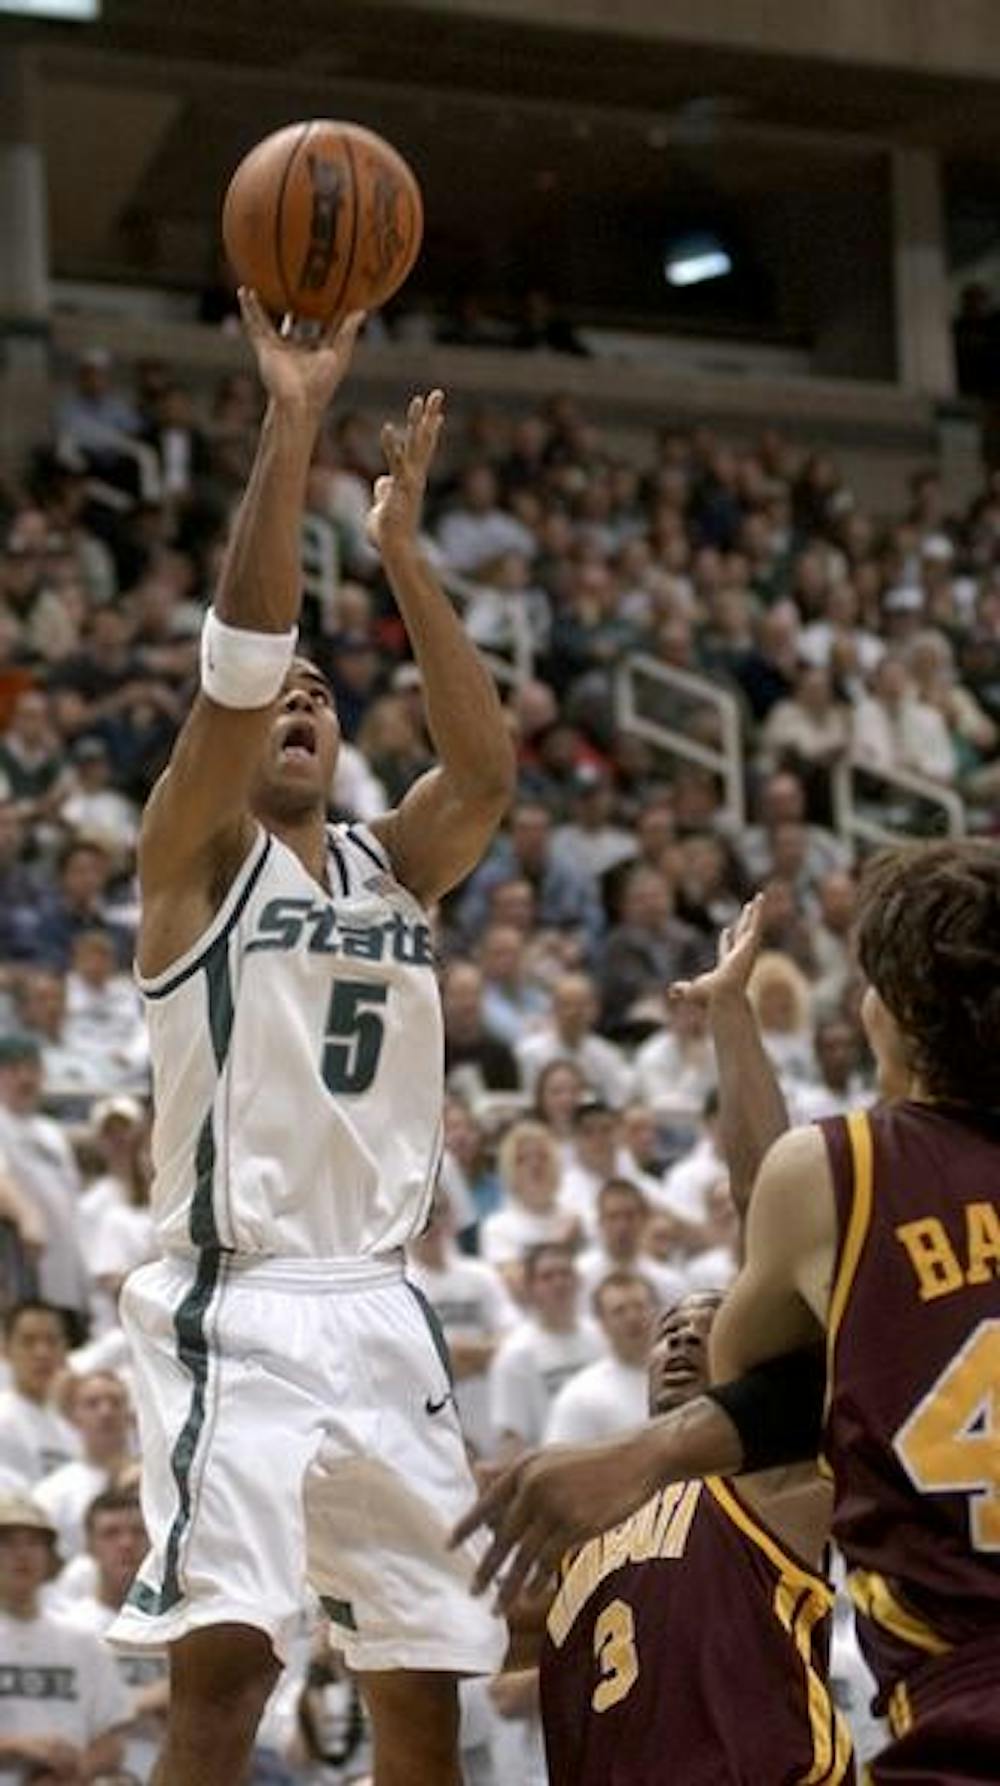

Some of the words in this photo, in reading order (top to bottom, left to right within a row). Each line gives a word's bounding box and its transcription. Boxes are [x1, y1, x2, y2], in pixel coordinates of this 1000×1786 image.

[320, 979, 389, 1095] 5
[892, 1317, 1000, 1552] 4
[590, 1598, 640, 1714] 3
